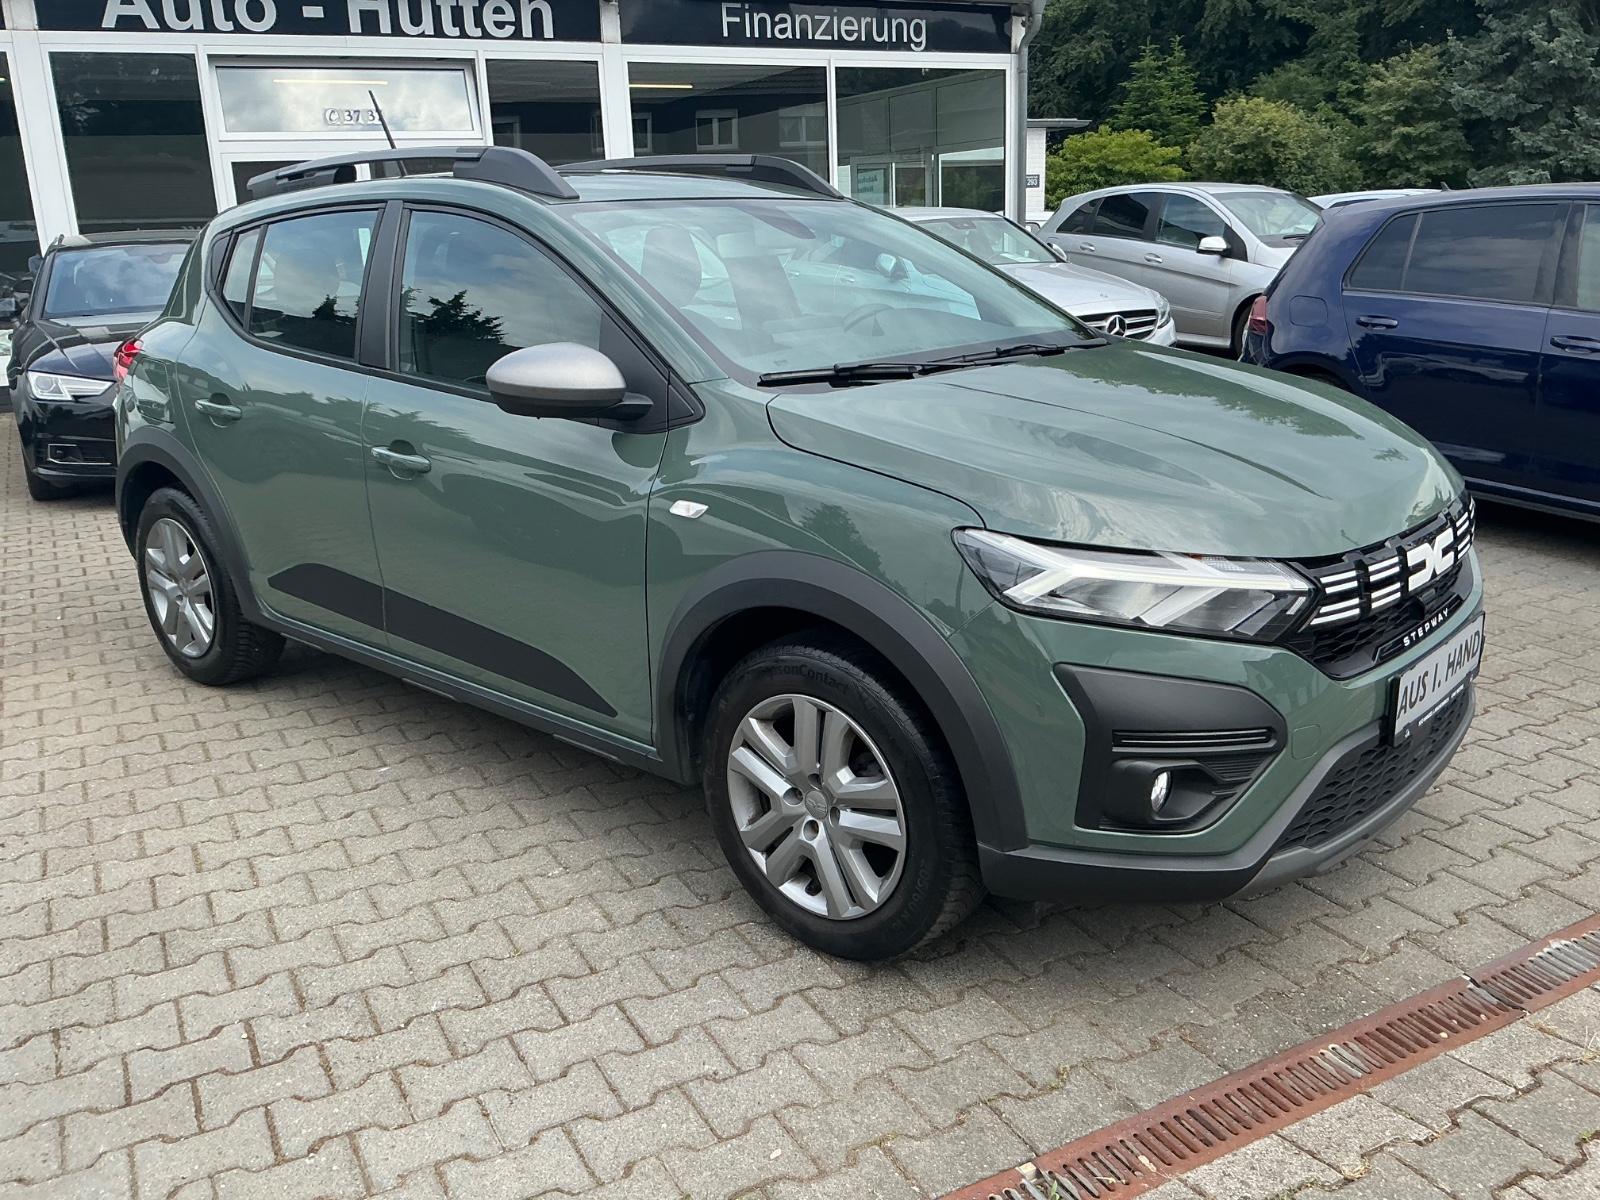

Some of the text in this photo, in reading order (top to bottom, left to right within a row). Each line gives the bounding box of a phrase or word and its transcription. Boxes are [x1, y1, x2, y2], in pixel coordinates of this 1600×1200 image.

[101, 0, 277, 32] Auto
[721, 3, 927, 52] Finanzierung
[344, 109, 361, 122] 37
[1402, 607, 1450, 647] STEPWAY
[1395, 670, 1429, 719] AUS
[1445, 630, 1481, 682] HAND
